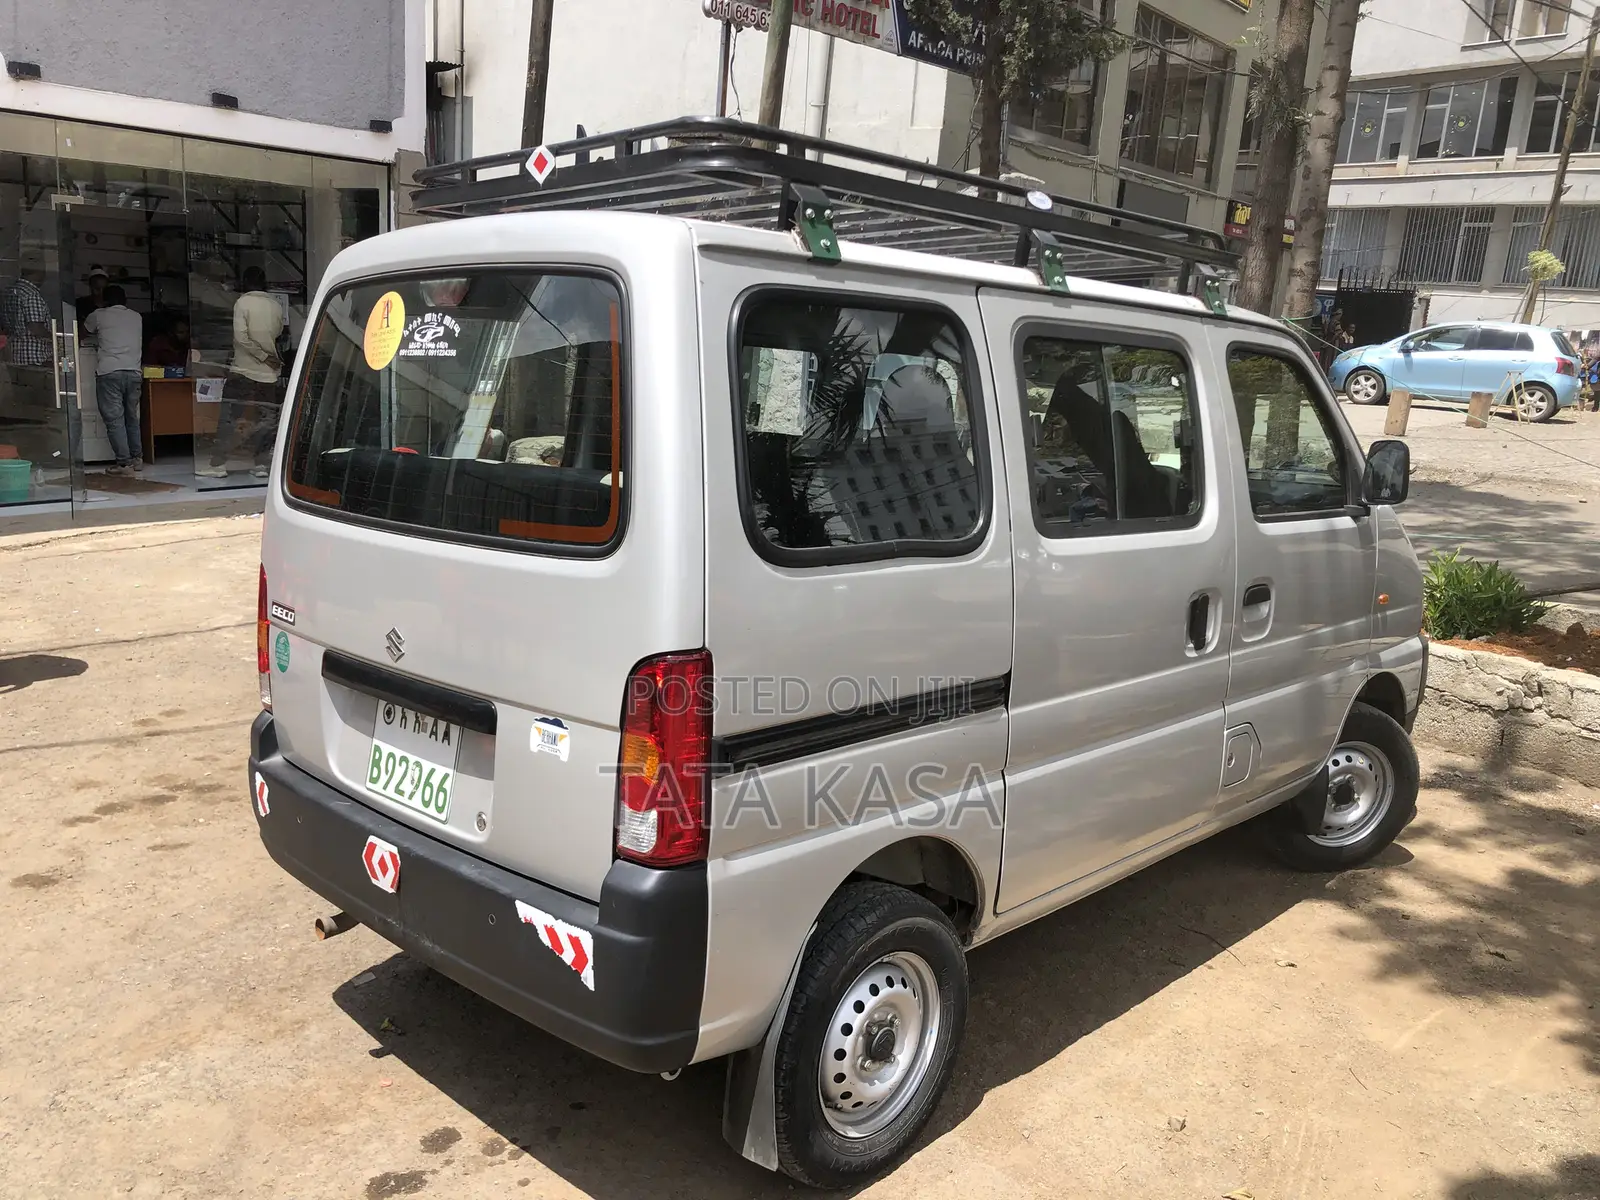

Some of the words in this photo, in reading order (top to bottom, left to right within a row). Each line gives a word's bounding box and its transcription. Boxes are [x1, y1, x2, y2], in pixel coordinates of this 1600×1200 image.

[711, 0, 731, 18] 011
[735, 5, 757, 23] 645
[821, 0, 880, 39] HOTEL
[272, 604, 295, 623] EECO
[368, 744, 450, 814] B92966
